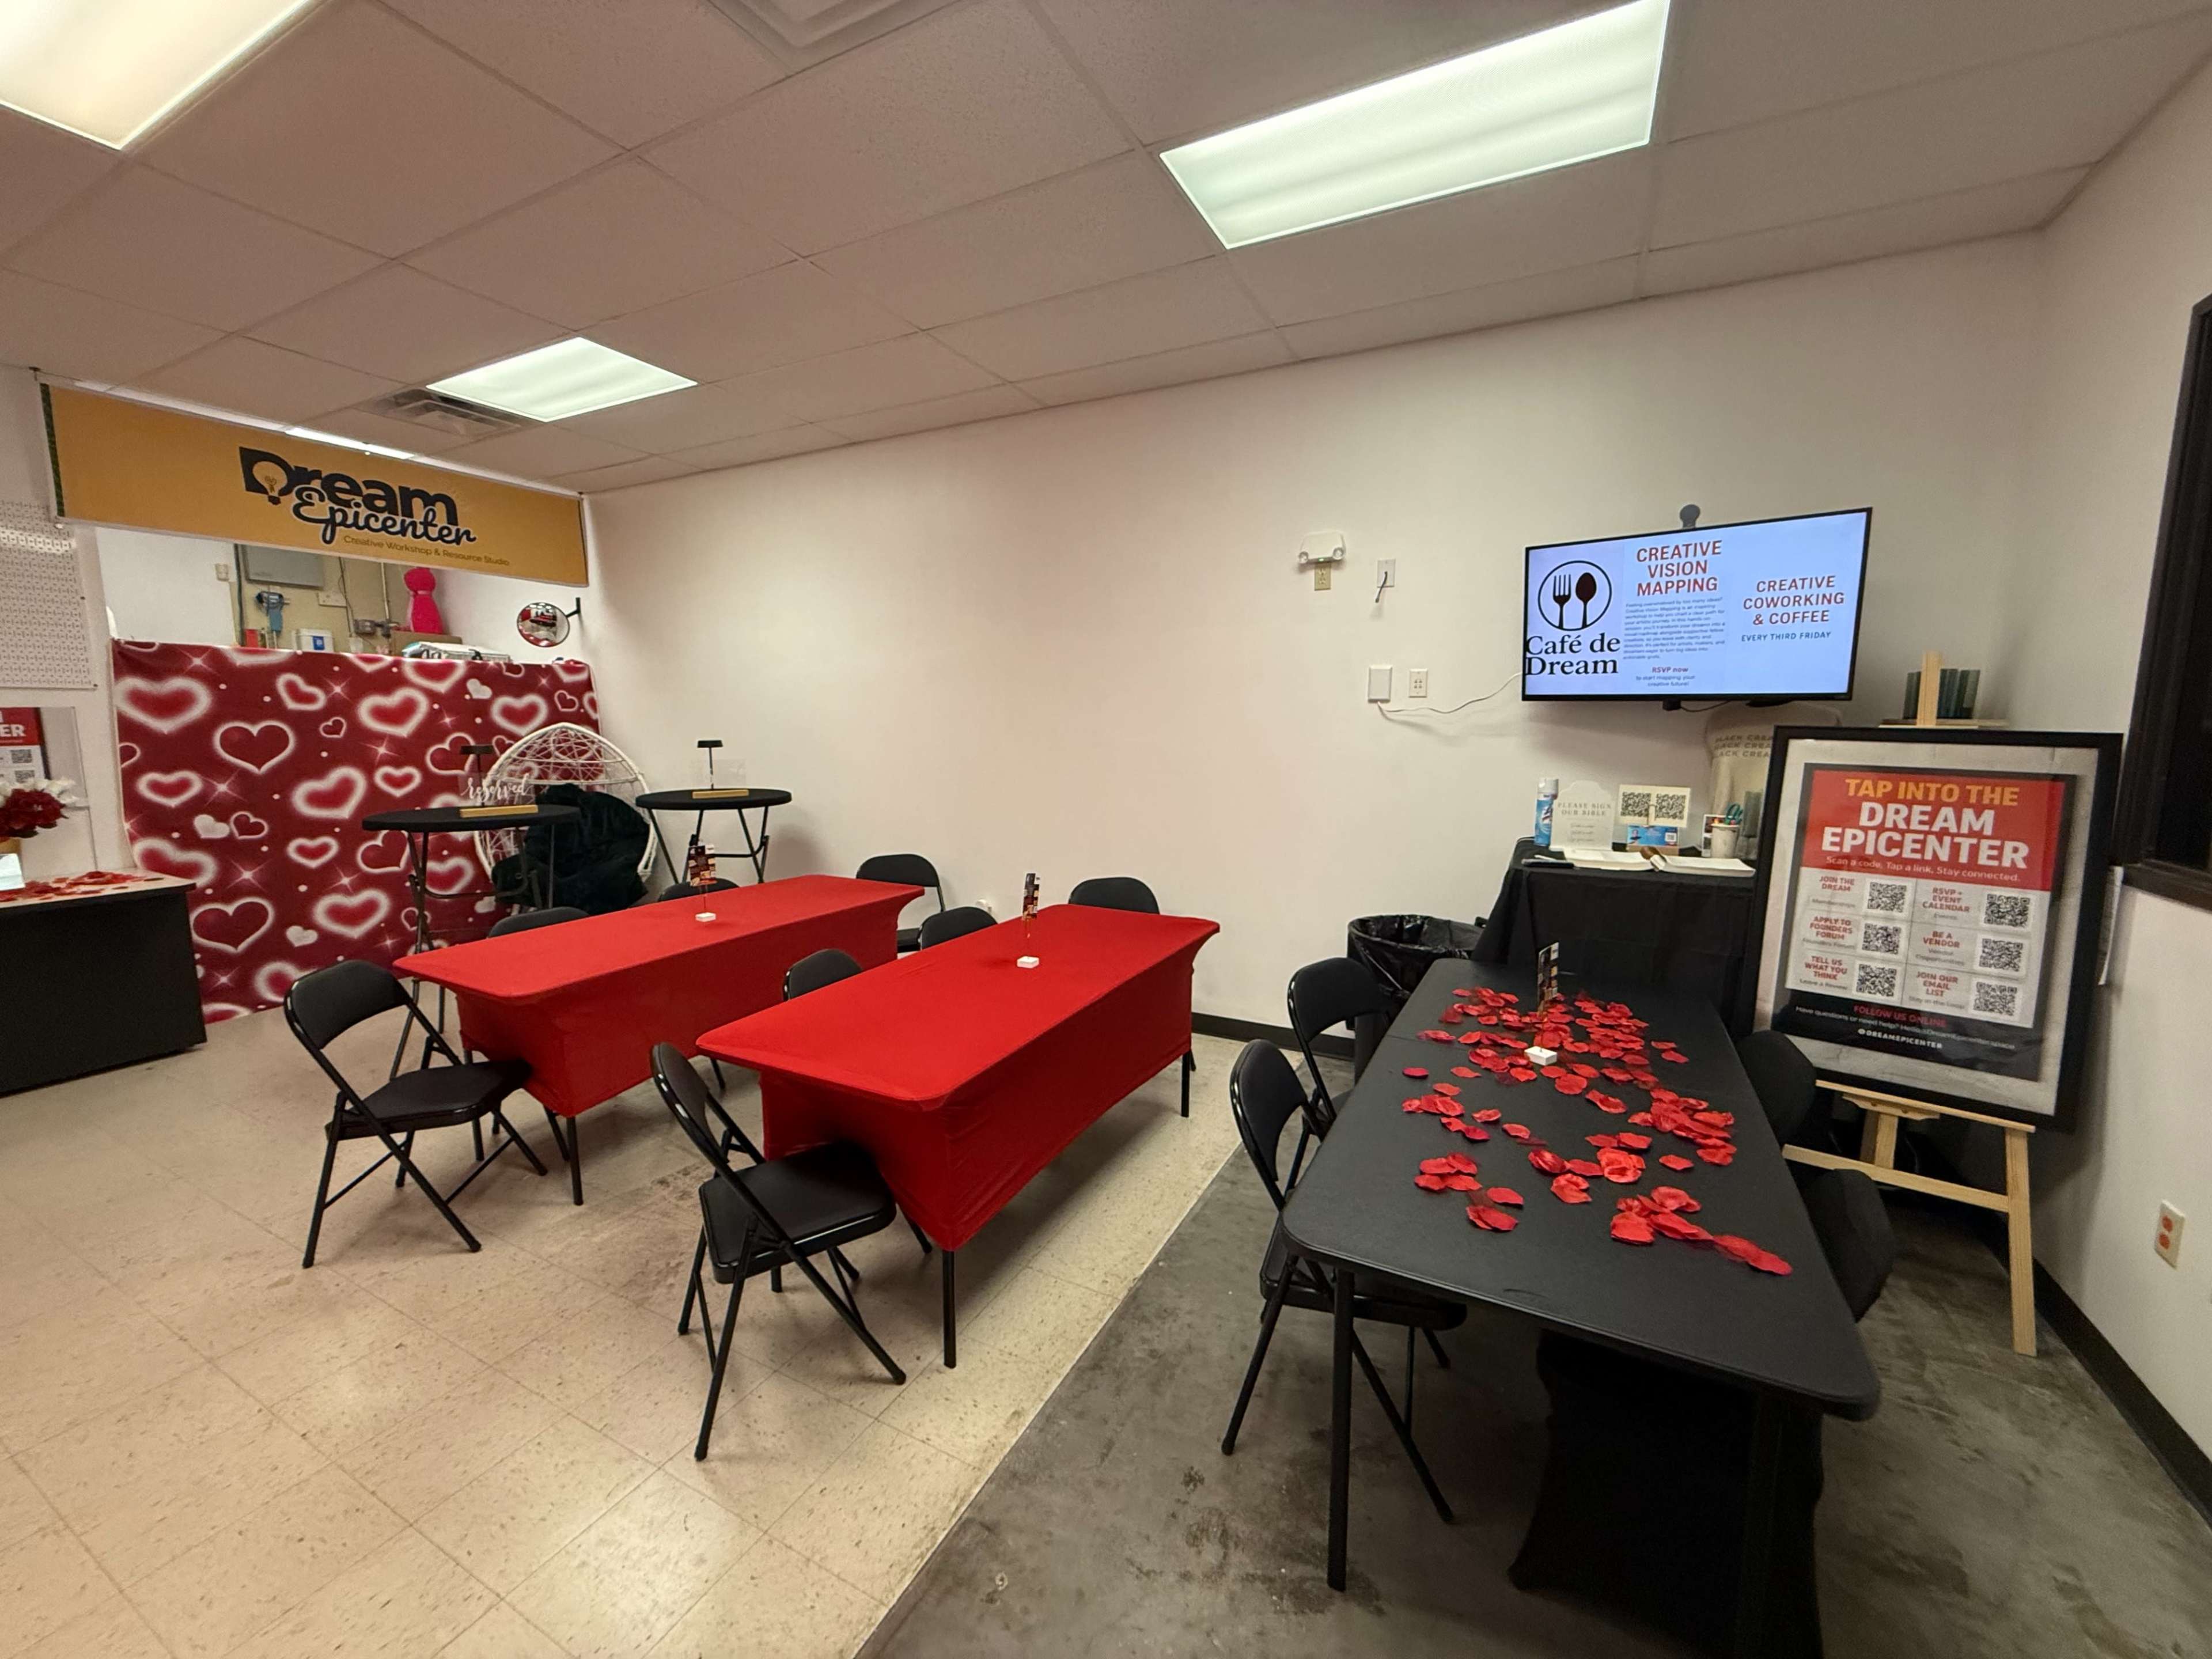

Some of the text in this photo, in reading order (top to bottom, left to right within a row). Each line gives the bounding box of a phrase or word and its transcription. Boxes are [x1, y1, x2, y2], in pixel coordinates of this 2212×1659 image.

[239, 446, 459, 526] Dream
[293, 485, 477, 545] Epicenter
[343, 535, 384, 548] Creative
[387, 541, 433, 556] Workshop
[442, 550, 483, 562] Resource
[484, 555, 510, 566] Studio
[1637, 540, 1722, 562] CREATIVE
[1647, 560, 1708, 578] VISION
[1637, 577, 1718, 596] MAPPING
[1756, 575, 1836, 593] CREATIVE
[1743, 592, 1845, 610] COWORKING
[1753, 610, 1830, 626] & COFFEE
[1800, 631, 1831, 639] FRIDAY
[1526, 632, 1621, 655] Café de
[1526, 657, 1619, 676] Dream
[460, 773, 535, 801] reserved
[1845, 778, 2020, 806] TAP INTO THE
[1858, 801, 1995, 836] DREAM
[1821, 827, 2029, 869] EPICENTER
[1826, 856, 1849, 866] Scan
[1858, 860, 1883, 869] code.
[1886, 862, 1903, 871] Tap
[1913, 865, 1934, 874] link.
[1937, 866, 1960, 877] Stay
[1961, 870, 2021, 882] connected.
[1821, 884, 1851, 892] DREAM
[1840, 877, 1855, 885] THE
[1932, 887, 1956, 896] RSVP
[1922, 901, 1970, 913] CALENDAR
[1809, 923, 1853, 934] FOUNDERS
[1813, 916, 1839, 925] APPLY
[1816, 930, 1846, 940] FORUM
[1932, 930, 1945, 938] BE
[1923, 937, 1961, 948] VENDOR
[1804, 962, 1848, 975] WHAT YOU
[1811, 956, 1843, 967] TELL US
[1813, 971, 1838, 980] THINK
[1916, 971, 1959, 983] JOIN OUR
[1923, 980, 1950, 990] EMAIL
[1926, 988, 1945, 997] LIST
[1853, 1005, 1948, 1027] FOLLOW US ONLINE
